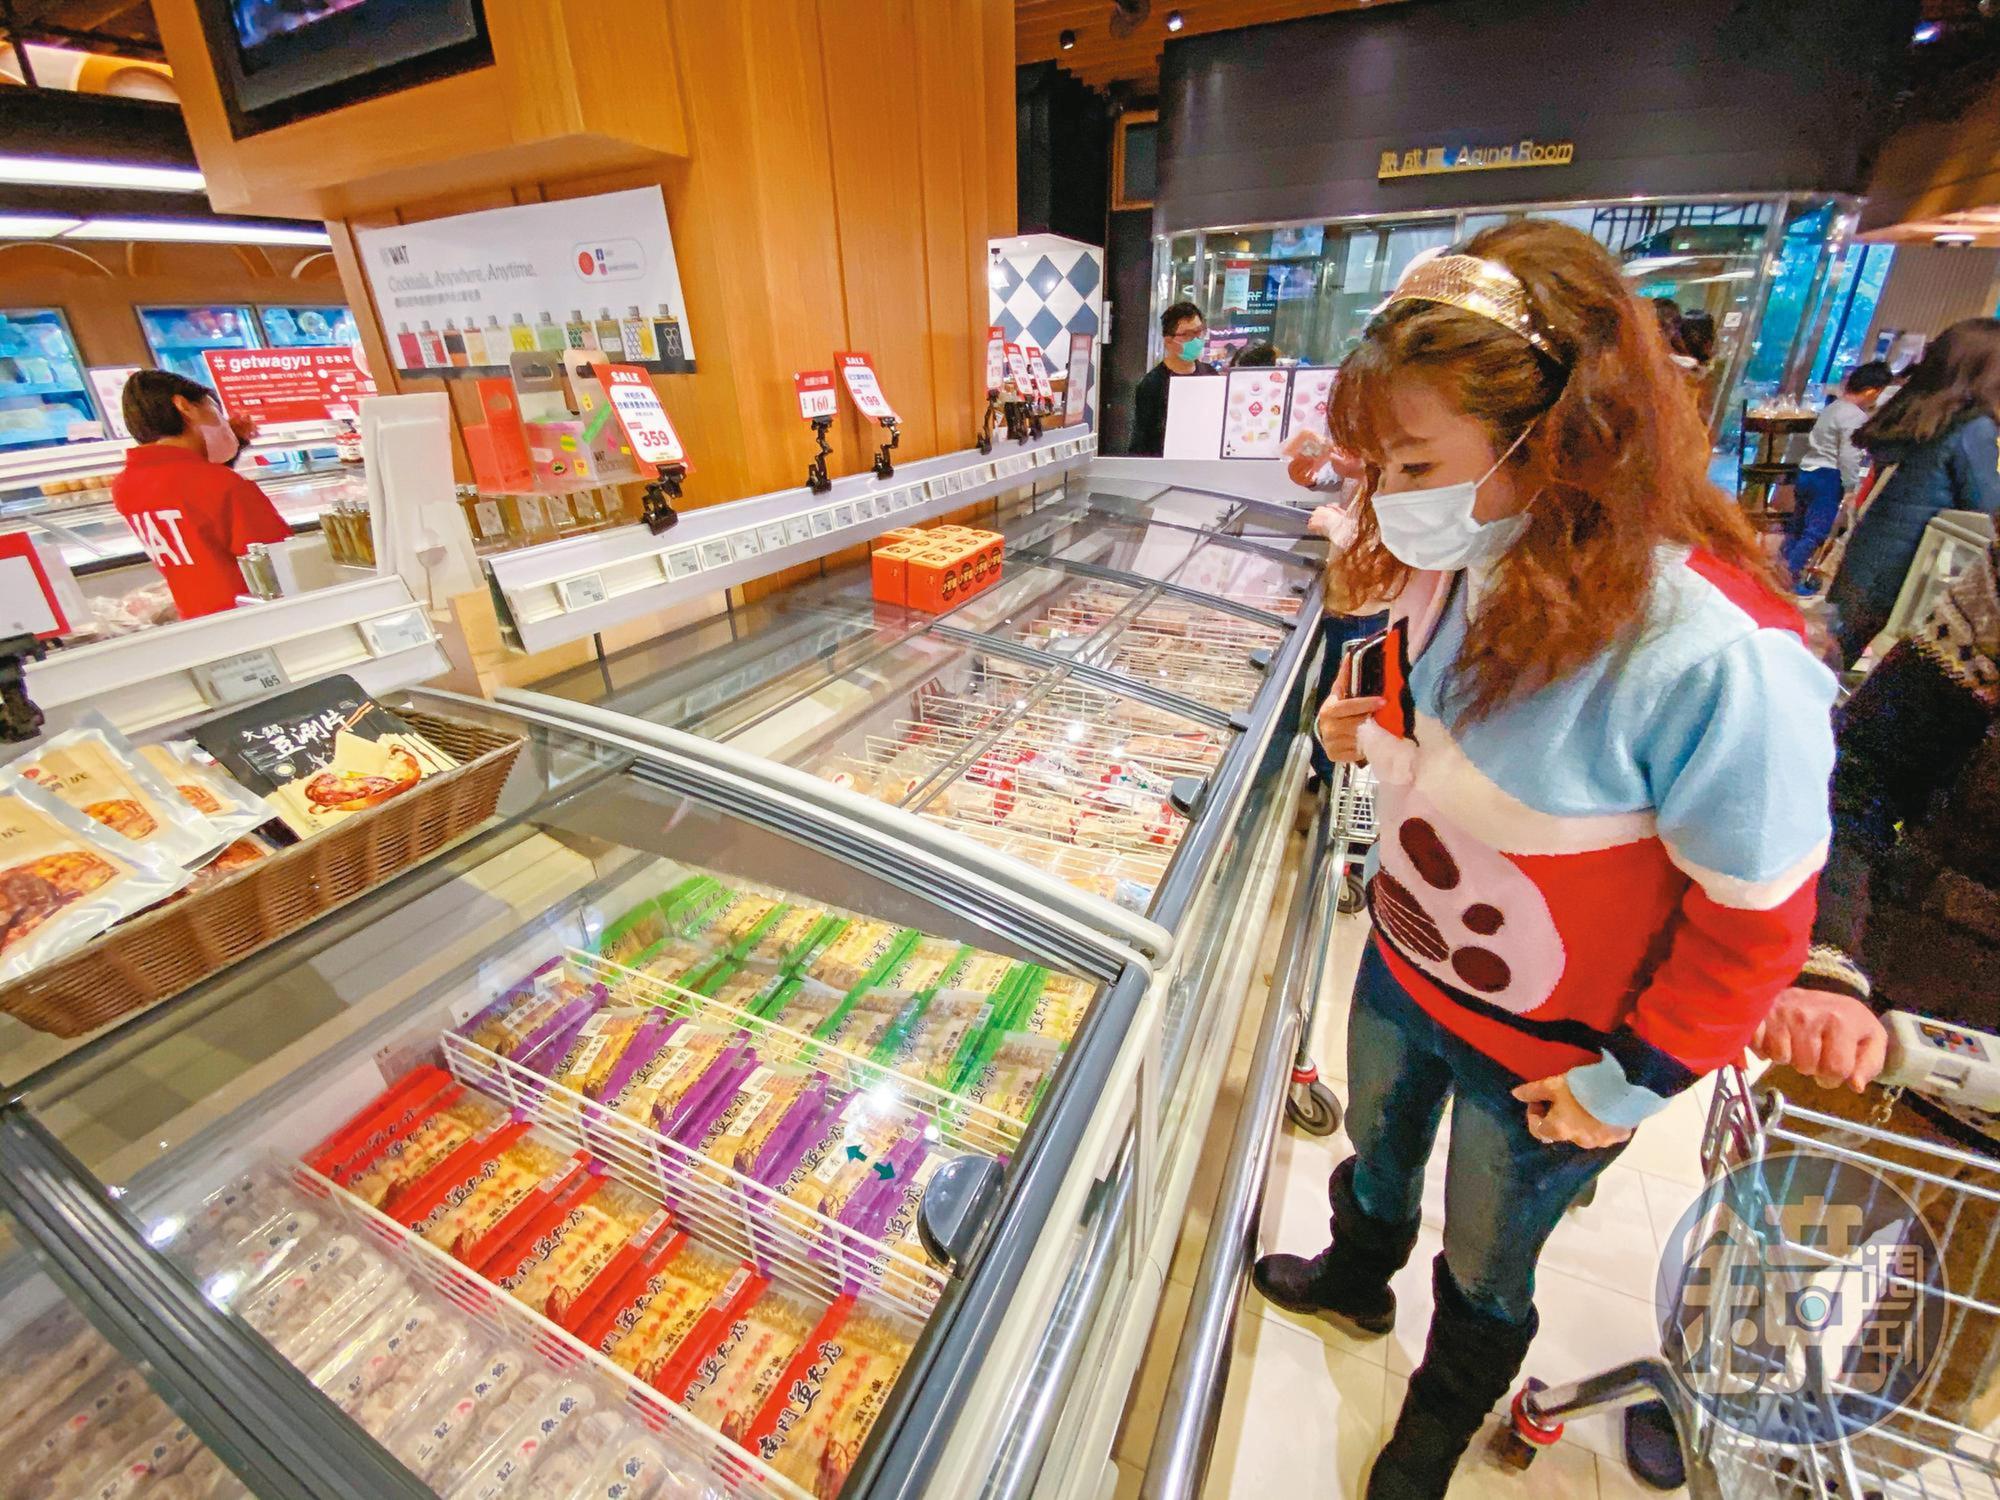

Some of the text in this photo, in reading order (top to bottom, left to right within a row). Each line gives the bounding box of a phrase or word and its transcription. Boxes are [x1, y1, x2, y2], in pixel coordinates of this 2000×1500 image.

[1456, 145, 1513, 168] Aging
[1517, 140, 1574, 163] Room
[610, 371, 642, 383] SALE
[811, 396, 829, 413] 160
[861, 395, 881, 407] 199
[638, 430, 670, 447] 359
[259, 674, 281, 689] 165
[599, 1274, 667, 1356] 門魚丸店
[474, 1362, 509, 1398] 魚餃
[757, 1340, 844, 1462] 南門魚丸店
[540, 1396, 578, 1436] 魚餃
[607, 1456, 646, 1500] 魚餃
